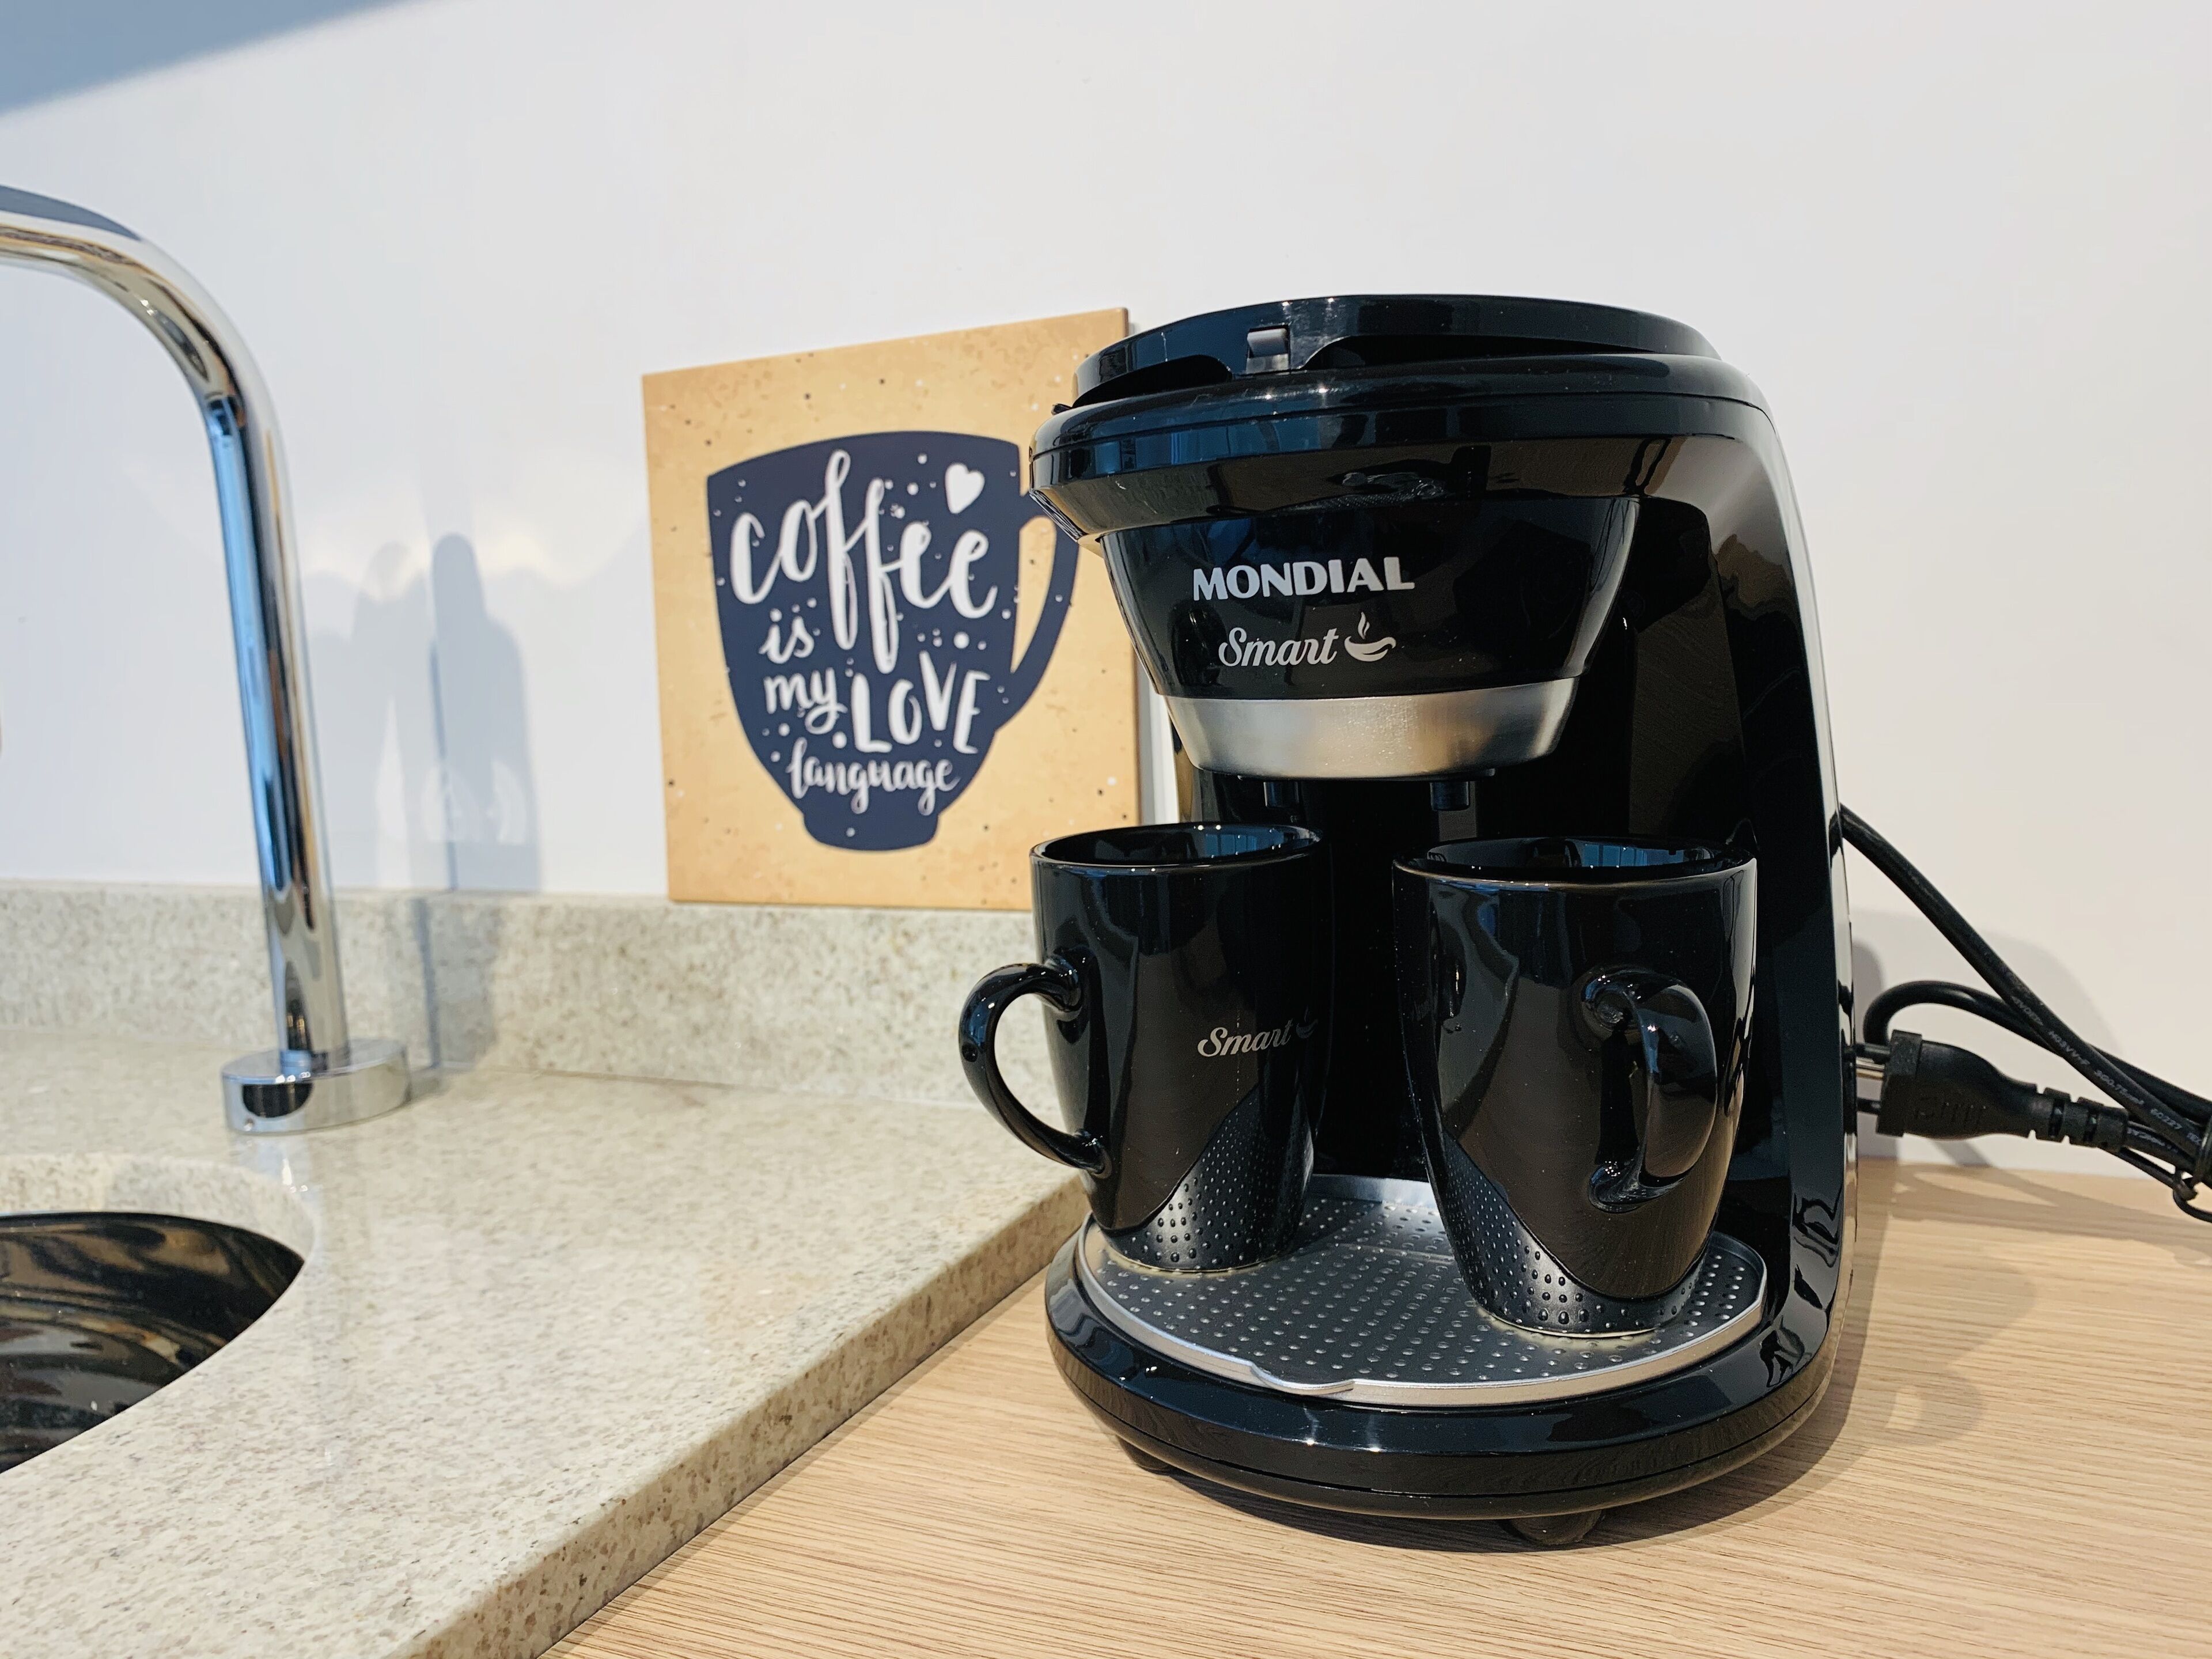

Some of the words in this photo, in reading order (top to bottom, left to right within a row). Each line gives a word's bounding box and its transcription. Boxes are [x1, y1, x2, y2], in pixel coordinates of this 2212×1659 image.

[730, 449, 998, 674] coffee
[1192, 556, 1415, 601] MONDIAL
[758, 608, 815, 664] is
[1218, 626, 1339, 667] Smart
[763, 666, 848, 735] my
[851, 650, 991, 755] LOVE
[786, 736, 961, 816] language
[1197, 1018, 1294, 1058] Smart
